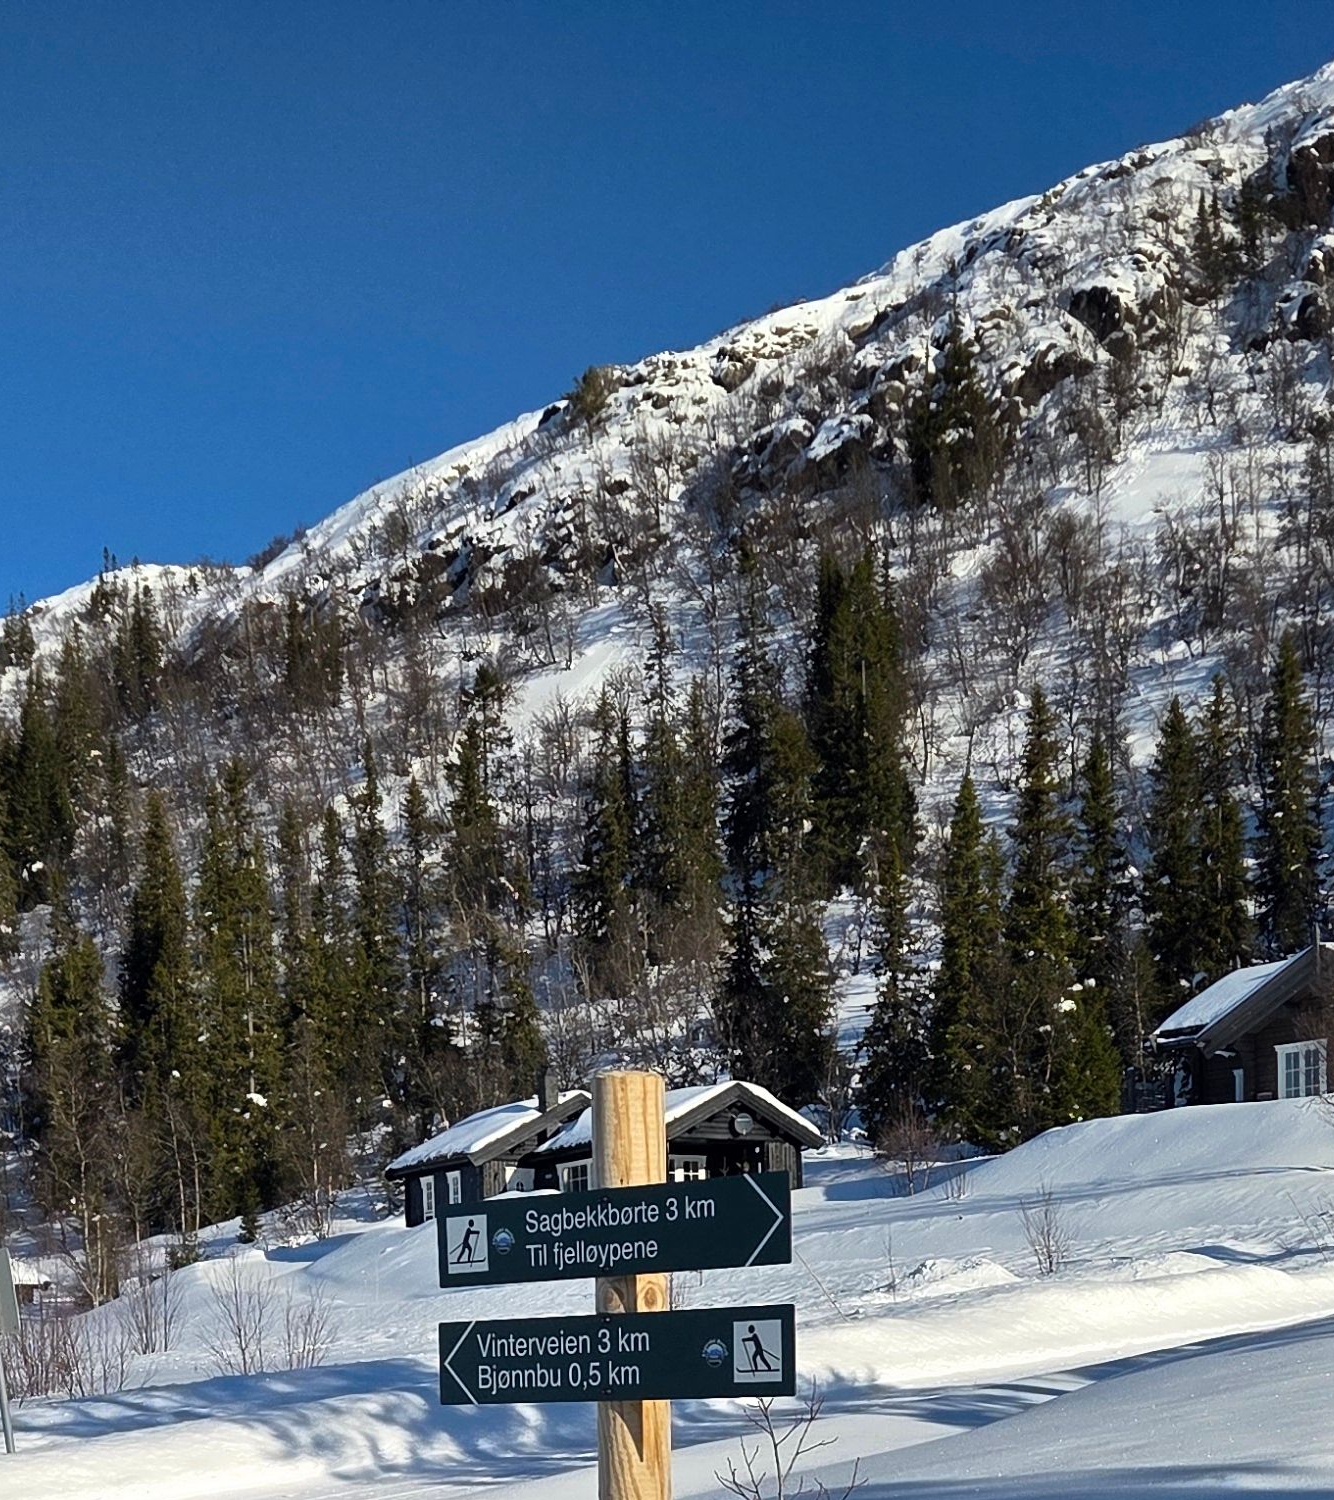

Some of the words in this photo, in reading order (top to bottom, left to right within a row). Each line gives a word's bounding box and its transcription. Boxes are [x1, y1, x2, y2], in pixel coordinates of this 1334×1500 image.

[525, 1201, 659, 1237] Sagbekkbørte
[666, 1198, 679, 1221] 3
[685, 1197, 715, 1219] km
[525, 1244, 547, 1267] Til
[552, 1240, 658, 1270] fjelløypene
[477, 1329, 590, 1358] Vinterveien
[597, 1329, 611, 1353] 3
[618, 1328, 650, 1352] km
[478, 1363, 561, 1395] Bjønnbu
[568, 1363, 601, 1391] 0,5
[608, 1363, 640, 1386] km
